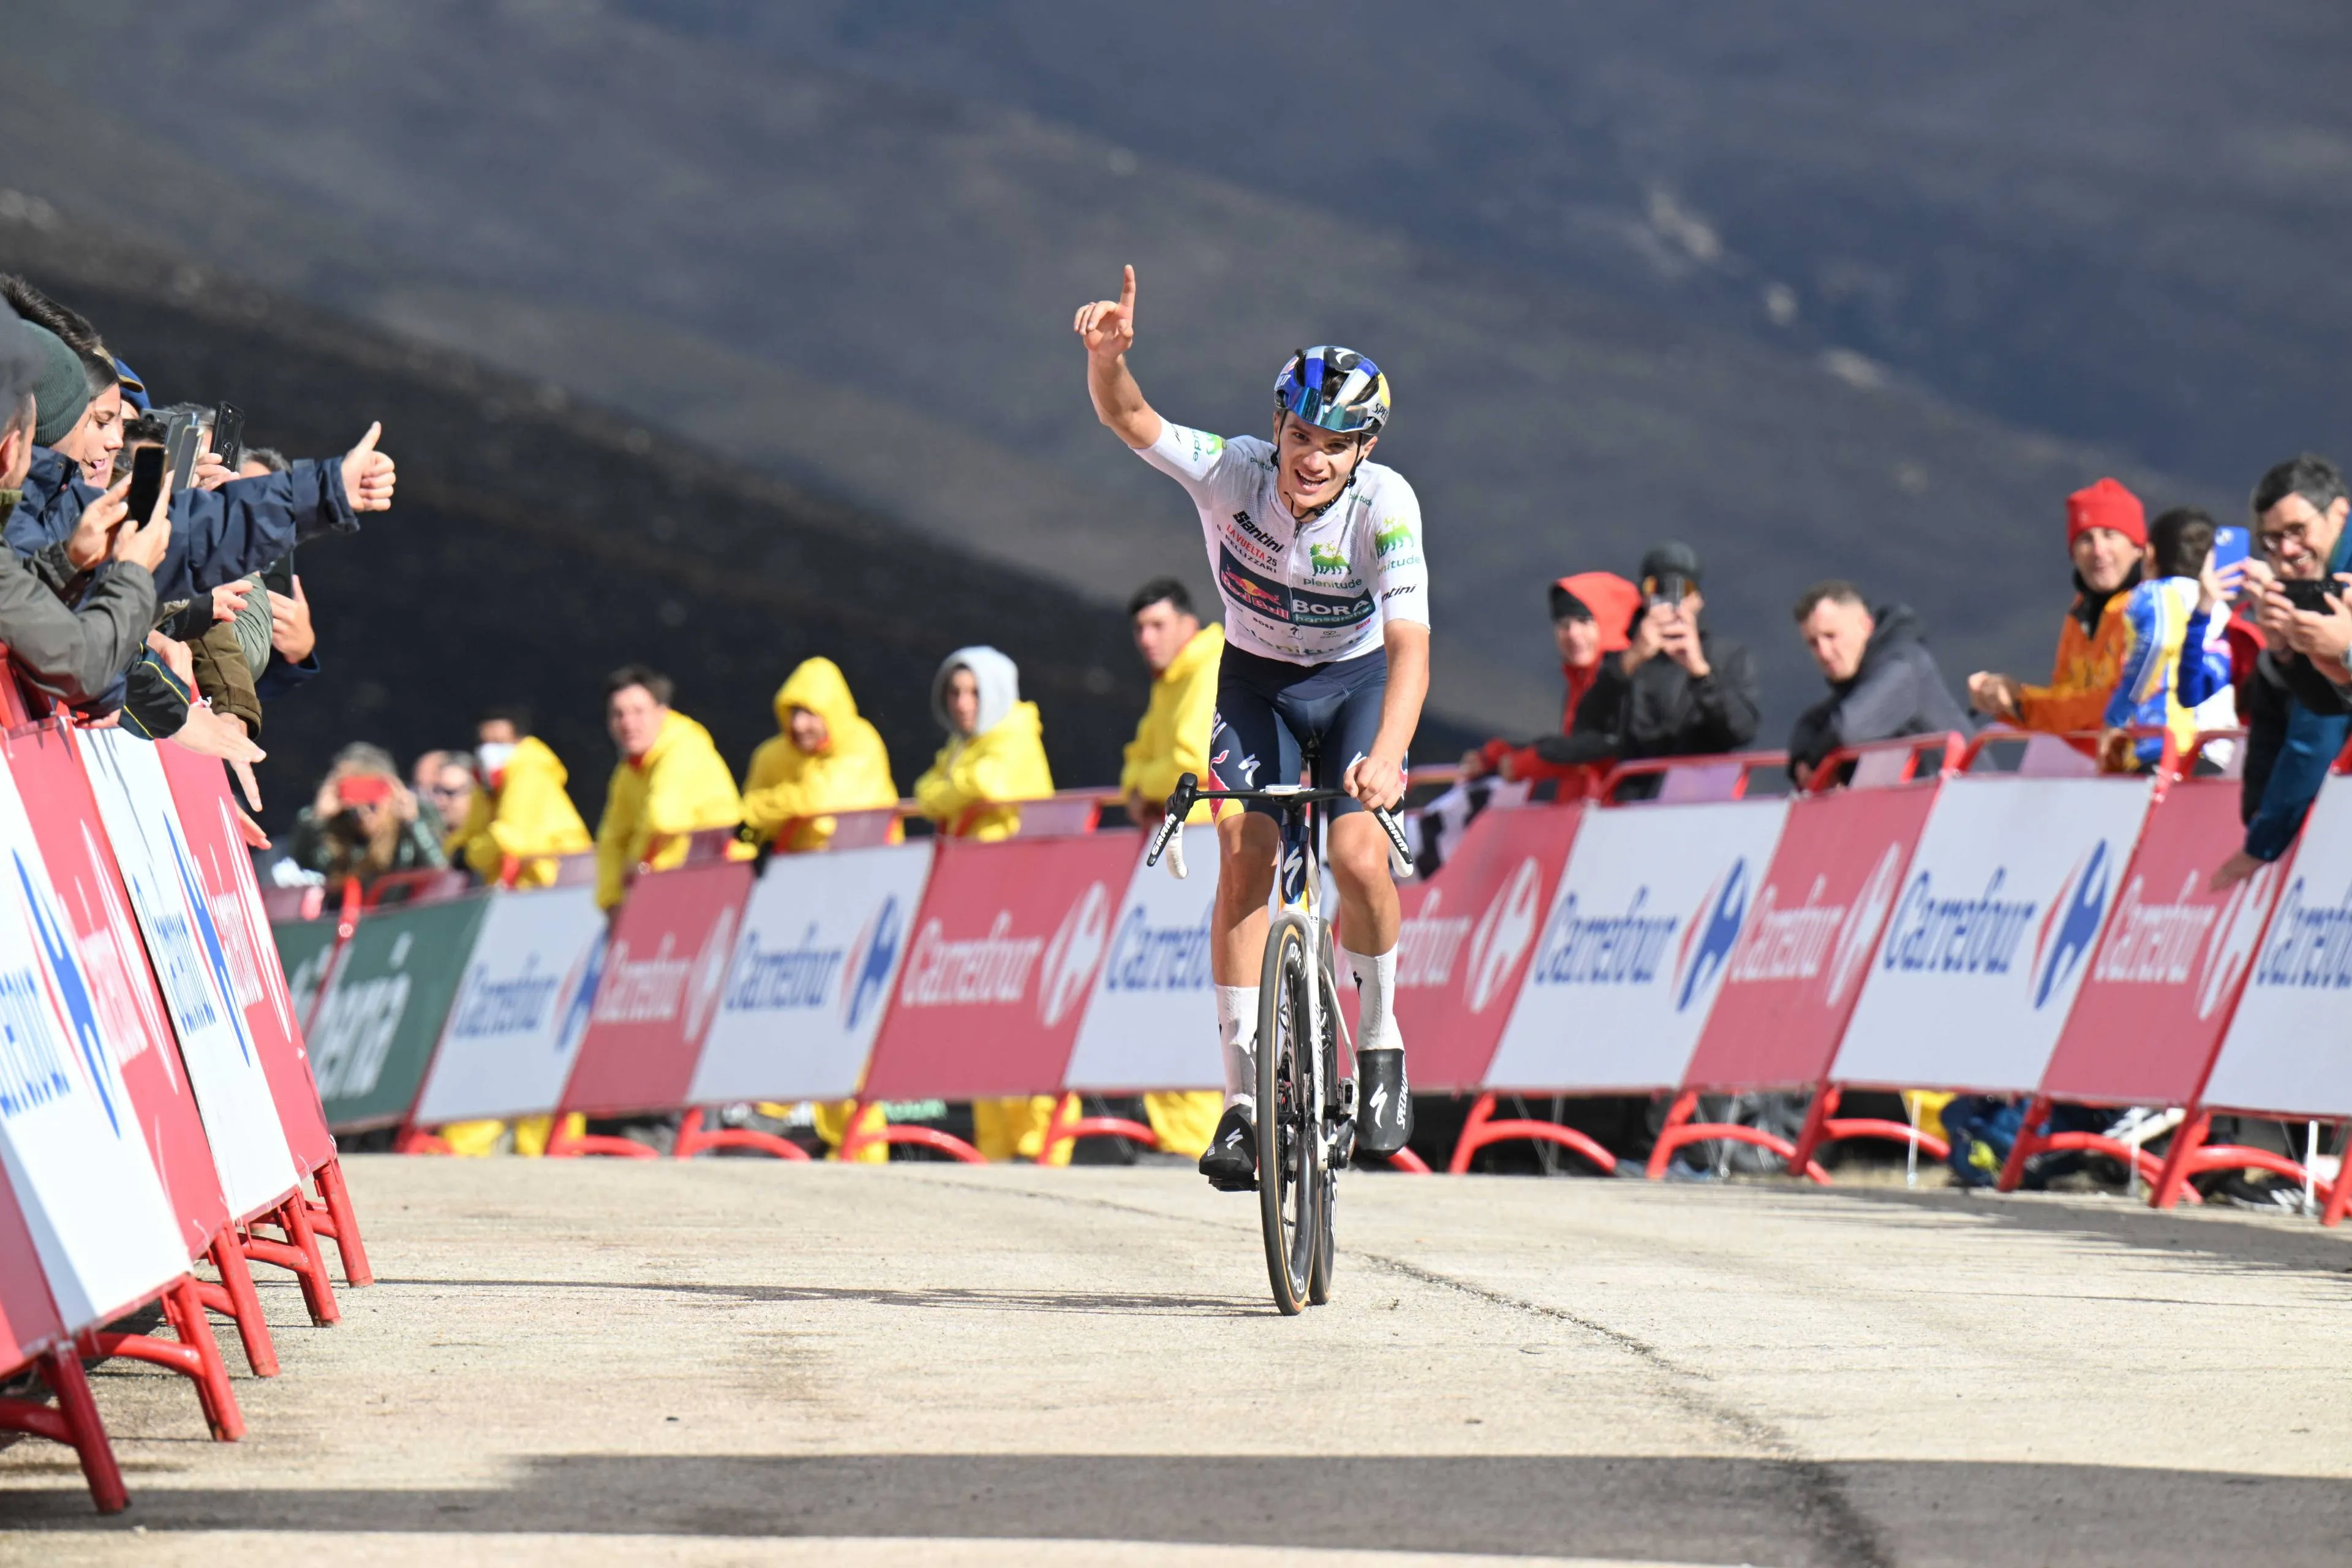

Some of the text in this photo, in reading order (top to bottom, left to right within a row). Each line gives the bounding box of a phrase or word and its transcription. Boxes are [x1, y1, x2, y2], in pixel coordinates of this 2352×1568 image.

[1227, 524, 1278, 567] LA VUELTA 25
[1232, 510, 1284, 553] Santini
[1221, 570, 1251, 604] Red
[1251, 596, 1289, 620] Bull
[1292, 599, 1370, 616] BORA
[1303, 578, 1362, 589] plenitude
[1152, 813, 1177, 856] SRAM
[1378, 806, 1409, 854] SRAM
[1535, 886, 1679, 985] Carrefour
[1883, 865, 2037, 973] Carrefour
[2094, 870, 2217, 984] Carrefour
[902, 910, 1040, 1007] Carrefour
